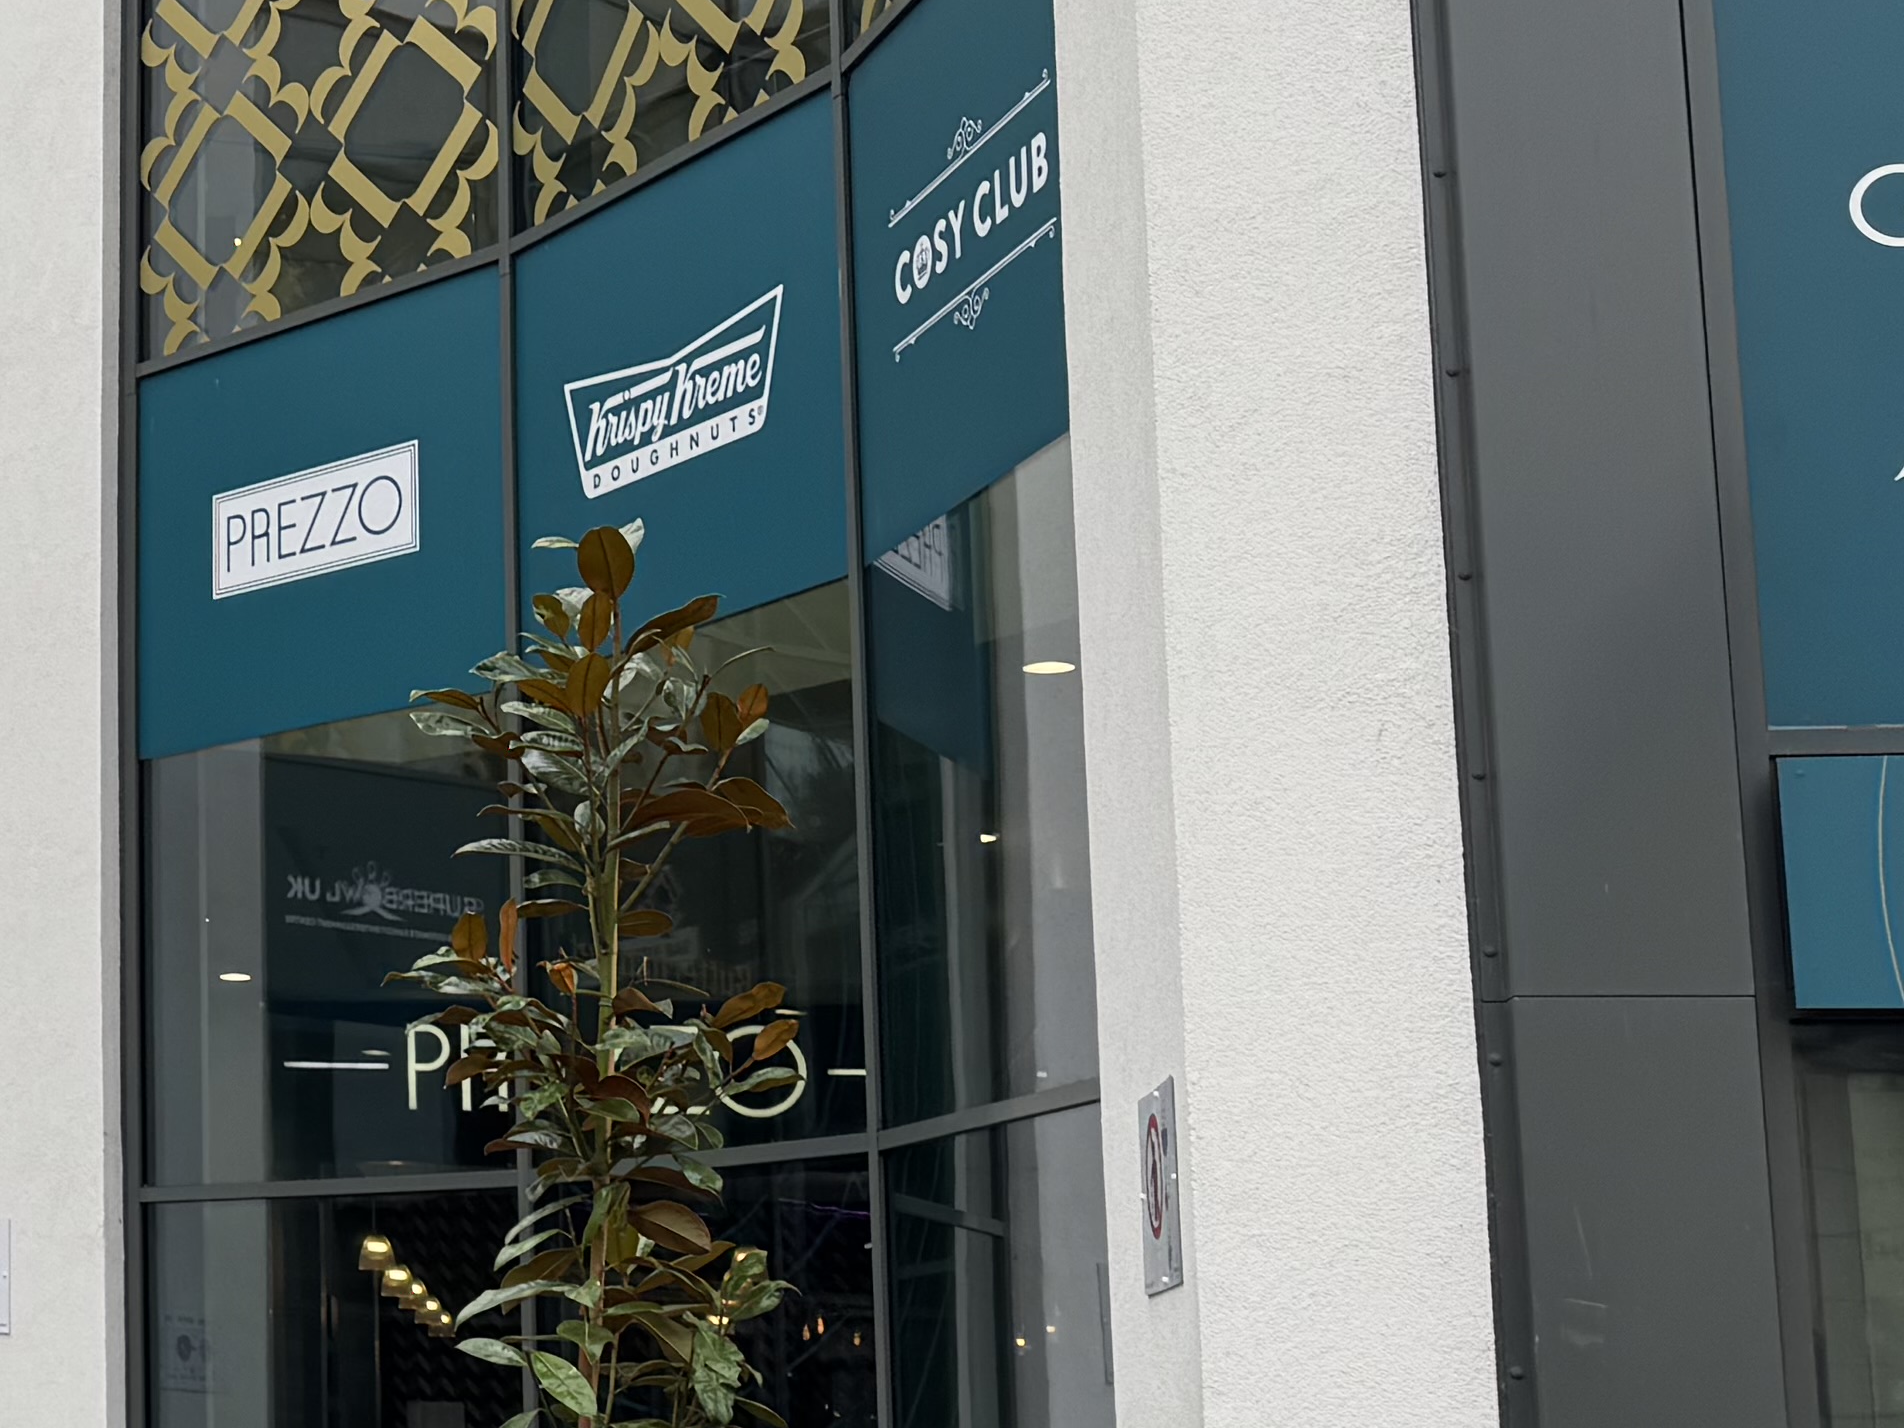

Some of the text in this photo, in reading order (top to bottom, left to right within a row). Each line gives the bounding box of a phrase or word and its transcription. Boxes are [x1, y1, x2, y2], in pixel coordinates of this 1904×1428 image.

[895, 132, 1049, 304] COSY CLUB
[584, 324, 766, 462] Krispy Kreme
[227, 475, 403, 573] PREZZO
